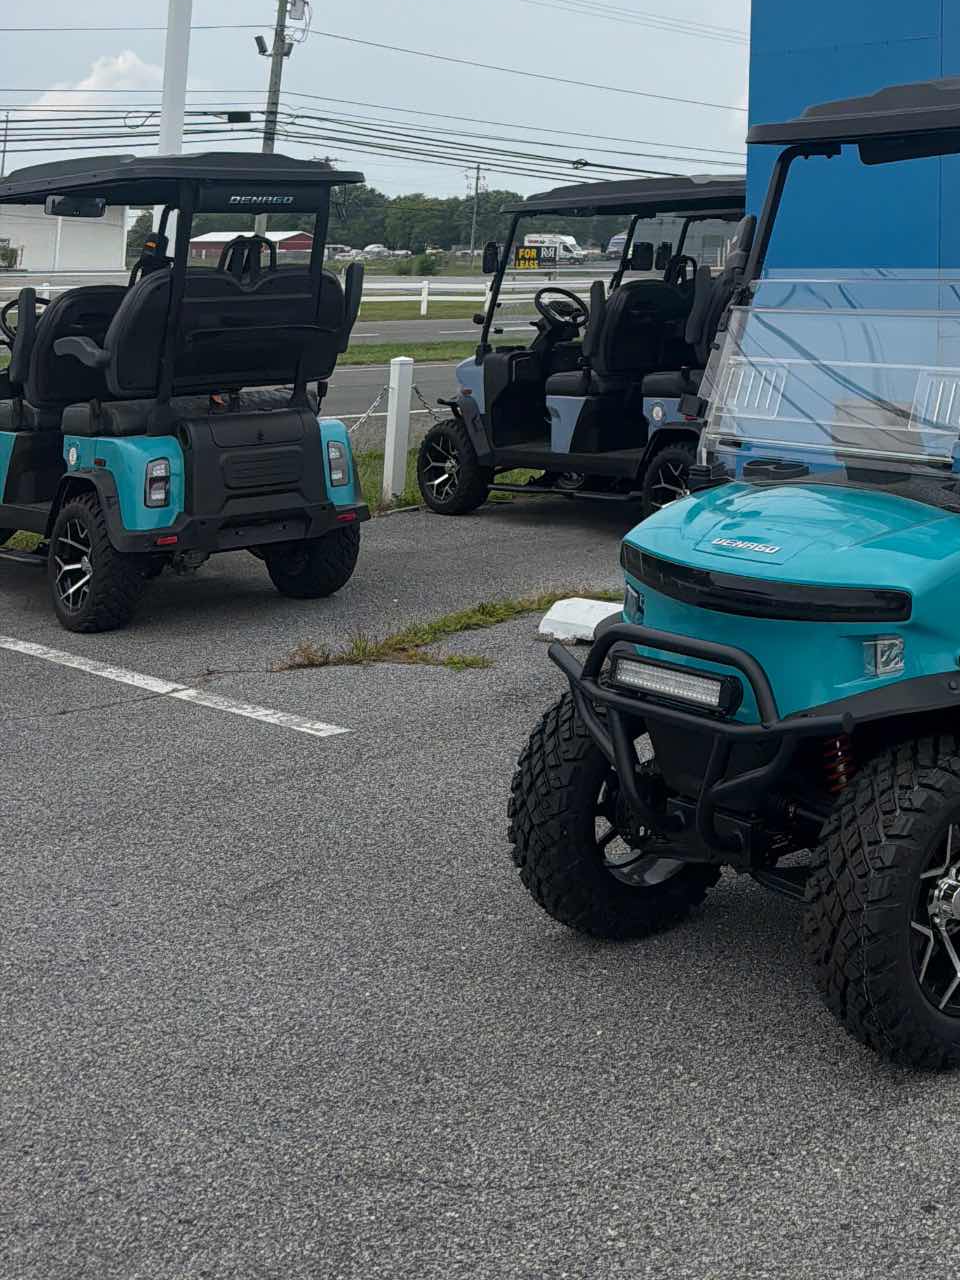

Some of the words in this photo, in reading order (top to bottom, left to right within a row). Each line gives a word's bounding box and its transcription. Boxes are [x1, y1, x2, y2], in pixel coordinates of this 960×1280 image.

[229, 195, 295, 205] DENAGO
[518, 247, 538, 259] FOR
[515, 260, 539, 270] LEASE
[711, 537, 783, 554] DENAGO
